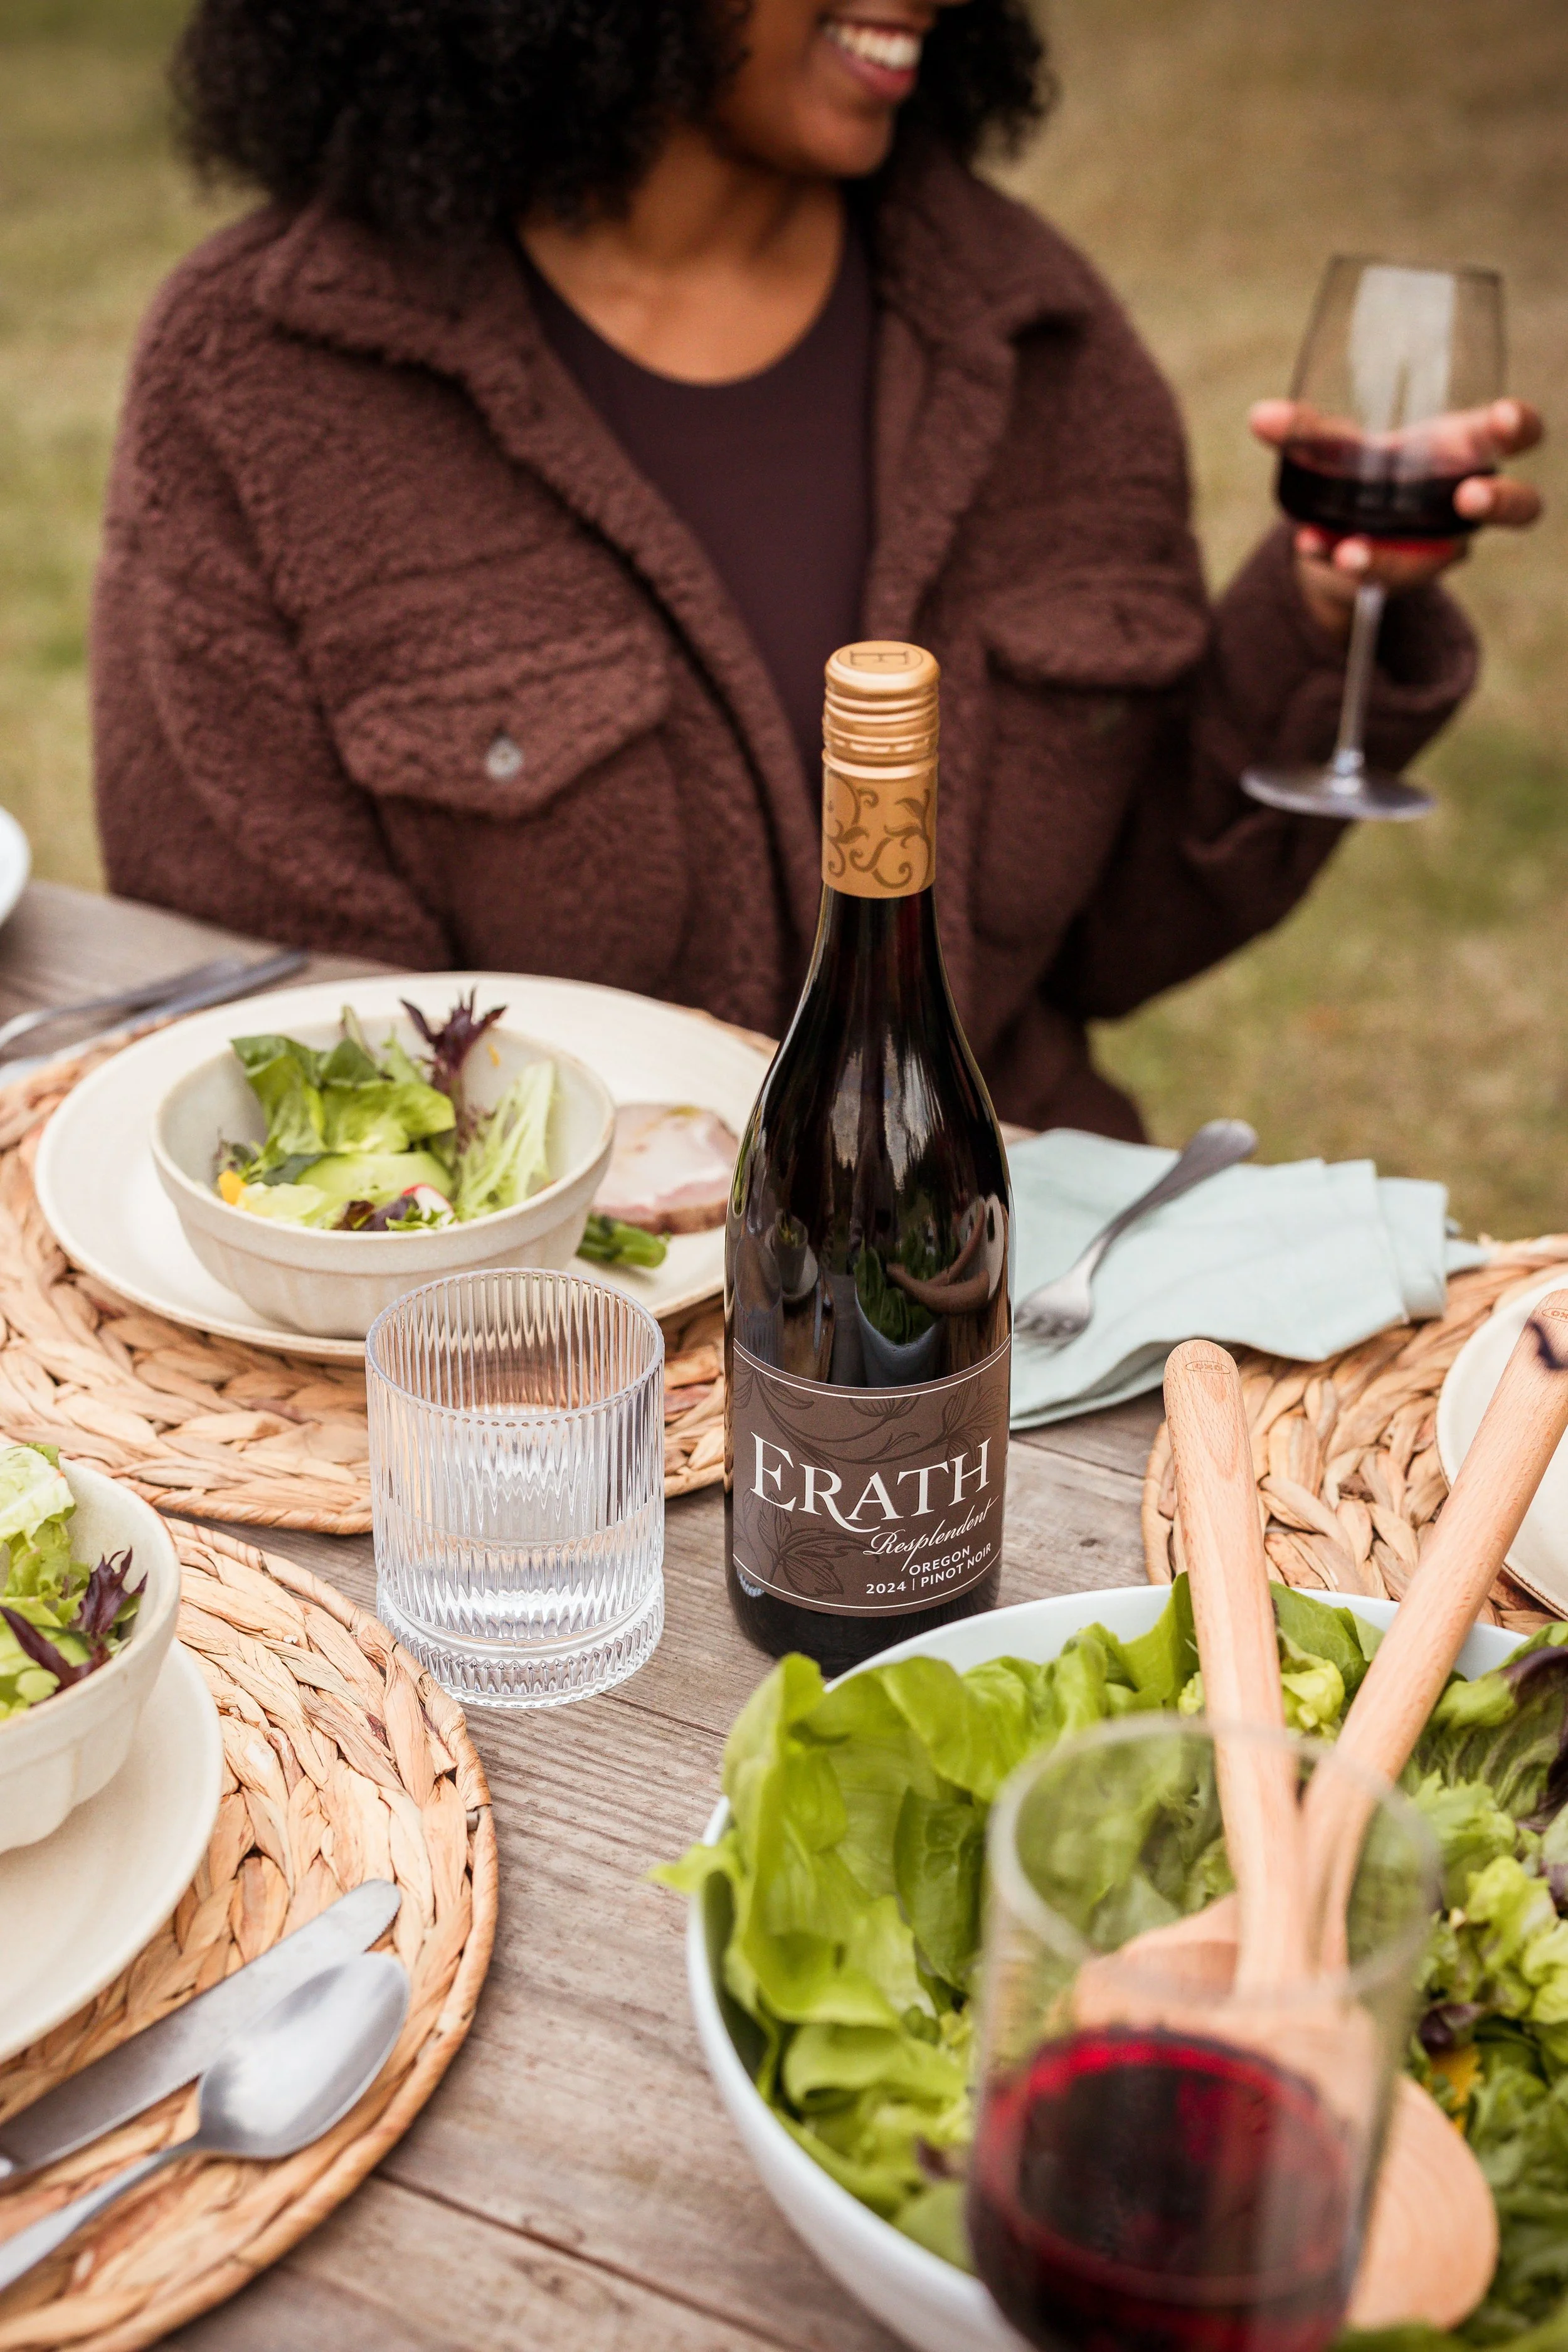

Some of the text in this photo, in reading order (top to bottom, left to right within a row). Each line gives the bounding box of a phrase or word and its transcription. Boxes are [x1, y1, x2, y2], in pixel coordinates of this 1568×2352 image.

[750, 1431, 992, 1532] ERATH
[862, 1495, 1000, 1572] Resplendent
[909, 1545, 970, 1576] OREGON
[866, 1542, 992, 1594] 2024 PINOT NOIR
